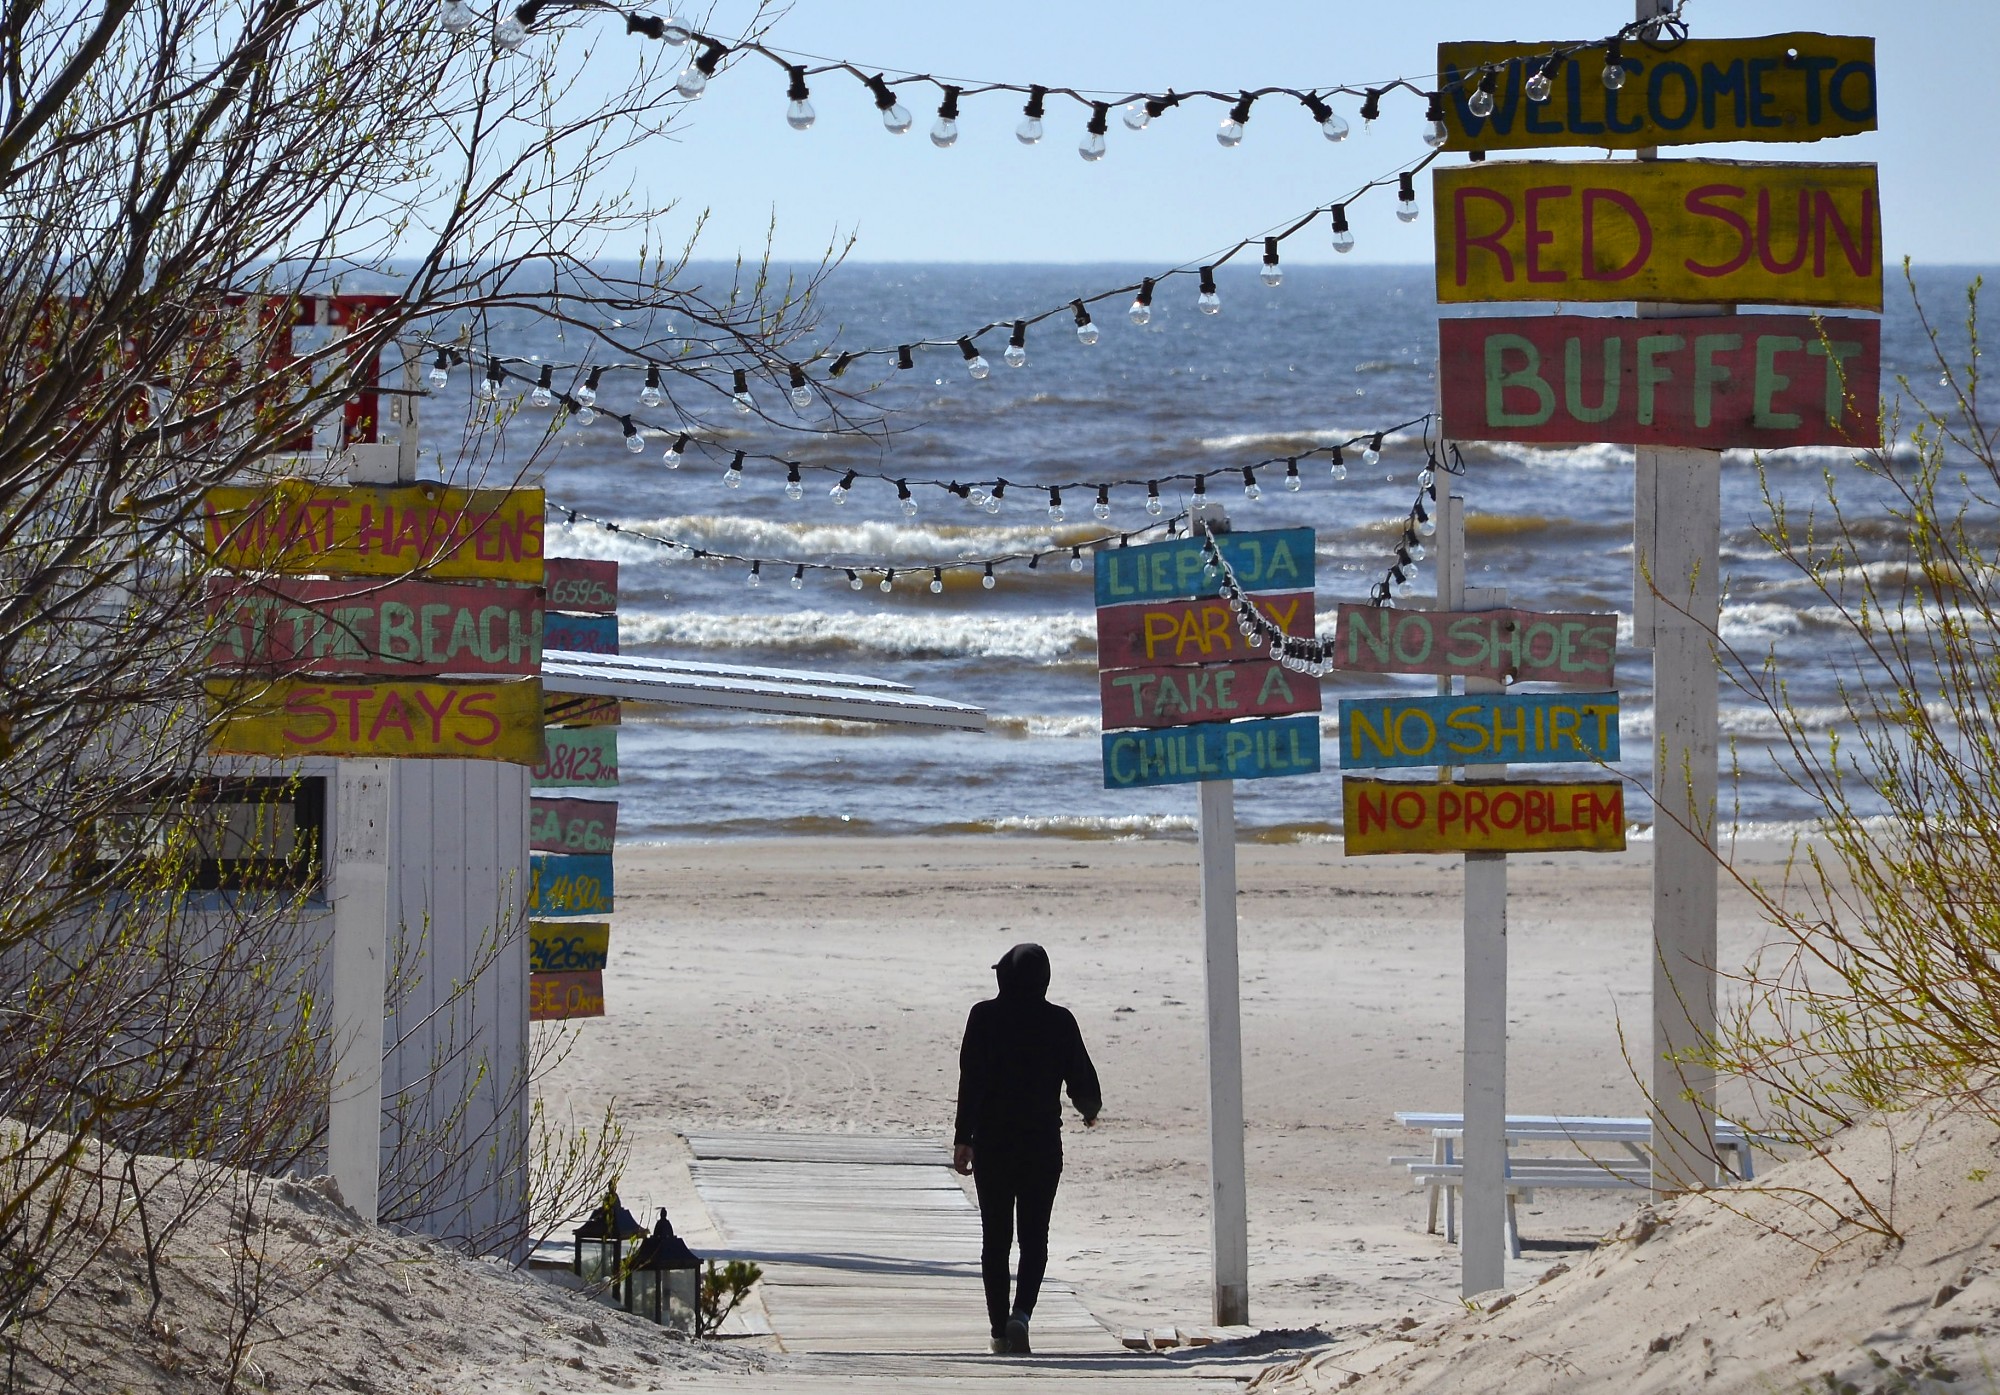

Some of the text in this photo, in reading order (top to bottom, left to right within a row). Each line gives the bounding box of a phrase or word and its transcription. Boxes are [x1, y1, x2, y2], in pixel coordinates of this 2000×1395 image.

[1446, 56, 1875, 137] WELCOME TO
[1454, 184, 1873, 286] RED SUN
[1484, 333, 1863, 430] BUFFET
[204, 499, 543, 562] WHAT HAPPENS
[1110, 539, 1298, 596] LIEPJA
[281, 606, 375, 661] THE
[380, 602, 542, 665] BEACH
[1144, 601, 1298, 660] PARY
[1347, 611, 1615, 673] NO SHOES
[282, 687, 501, 744] STAYS
[1112, 665, 1294, 718] TAKE A
[1110, 728, 1313, 784] CHILL PILL
[1350, 704, 1619, 759] NO SHIRT
[1358, 790, 1622, 836] NO PROBLEM
